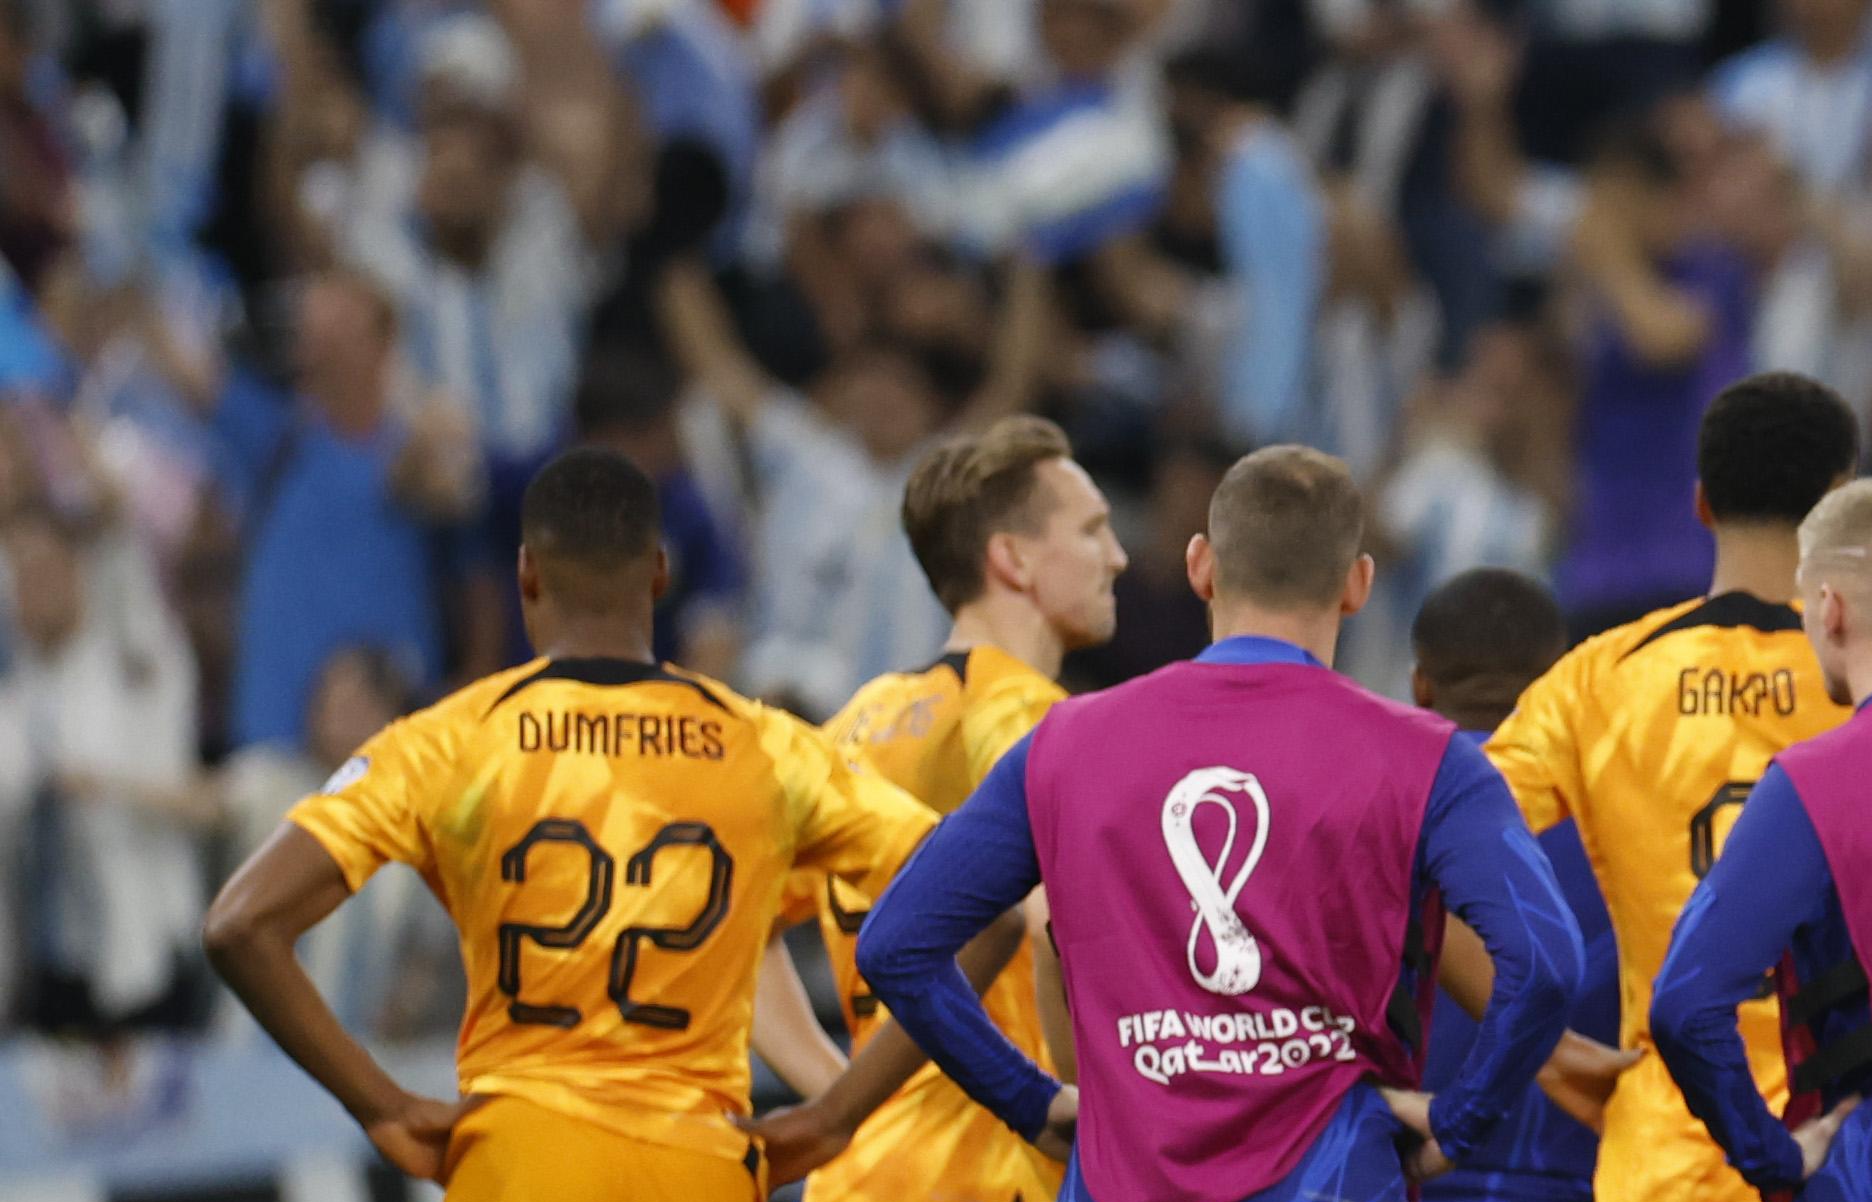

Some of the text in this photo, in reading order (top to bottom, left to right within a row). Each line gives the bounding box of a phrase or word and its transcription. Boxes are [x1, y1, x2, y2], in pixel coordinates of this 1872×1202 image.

[1678, 666, 1796, 717] GAKPO
[518, 711, 725, 760] DUMFRIES
[499, 817, 735, 1029] 22
[1117, 1008, 1186, 1048] FIFA
[1184, 1007, 1299, 1044] WORLD
